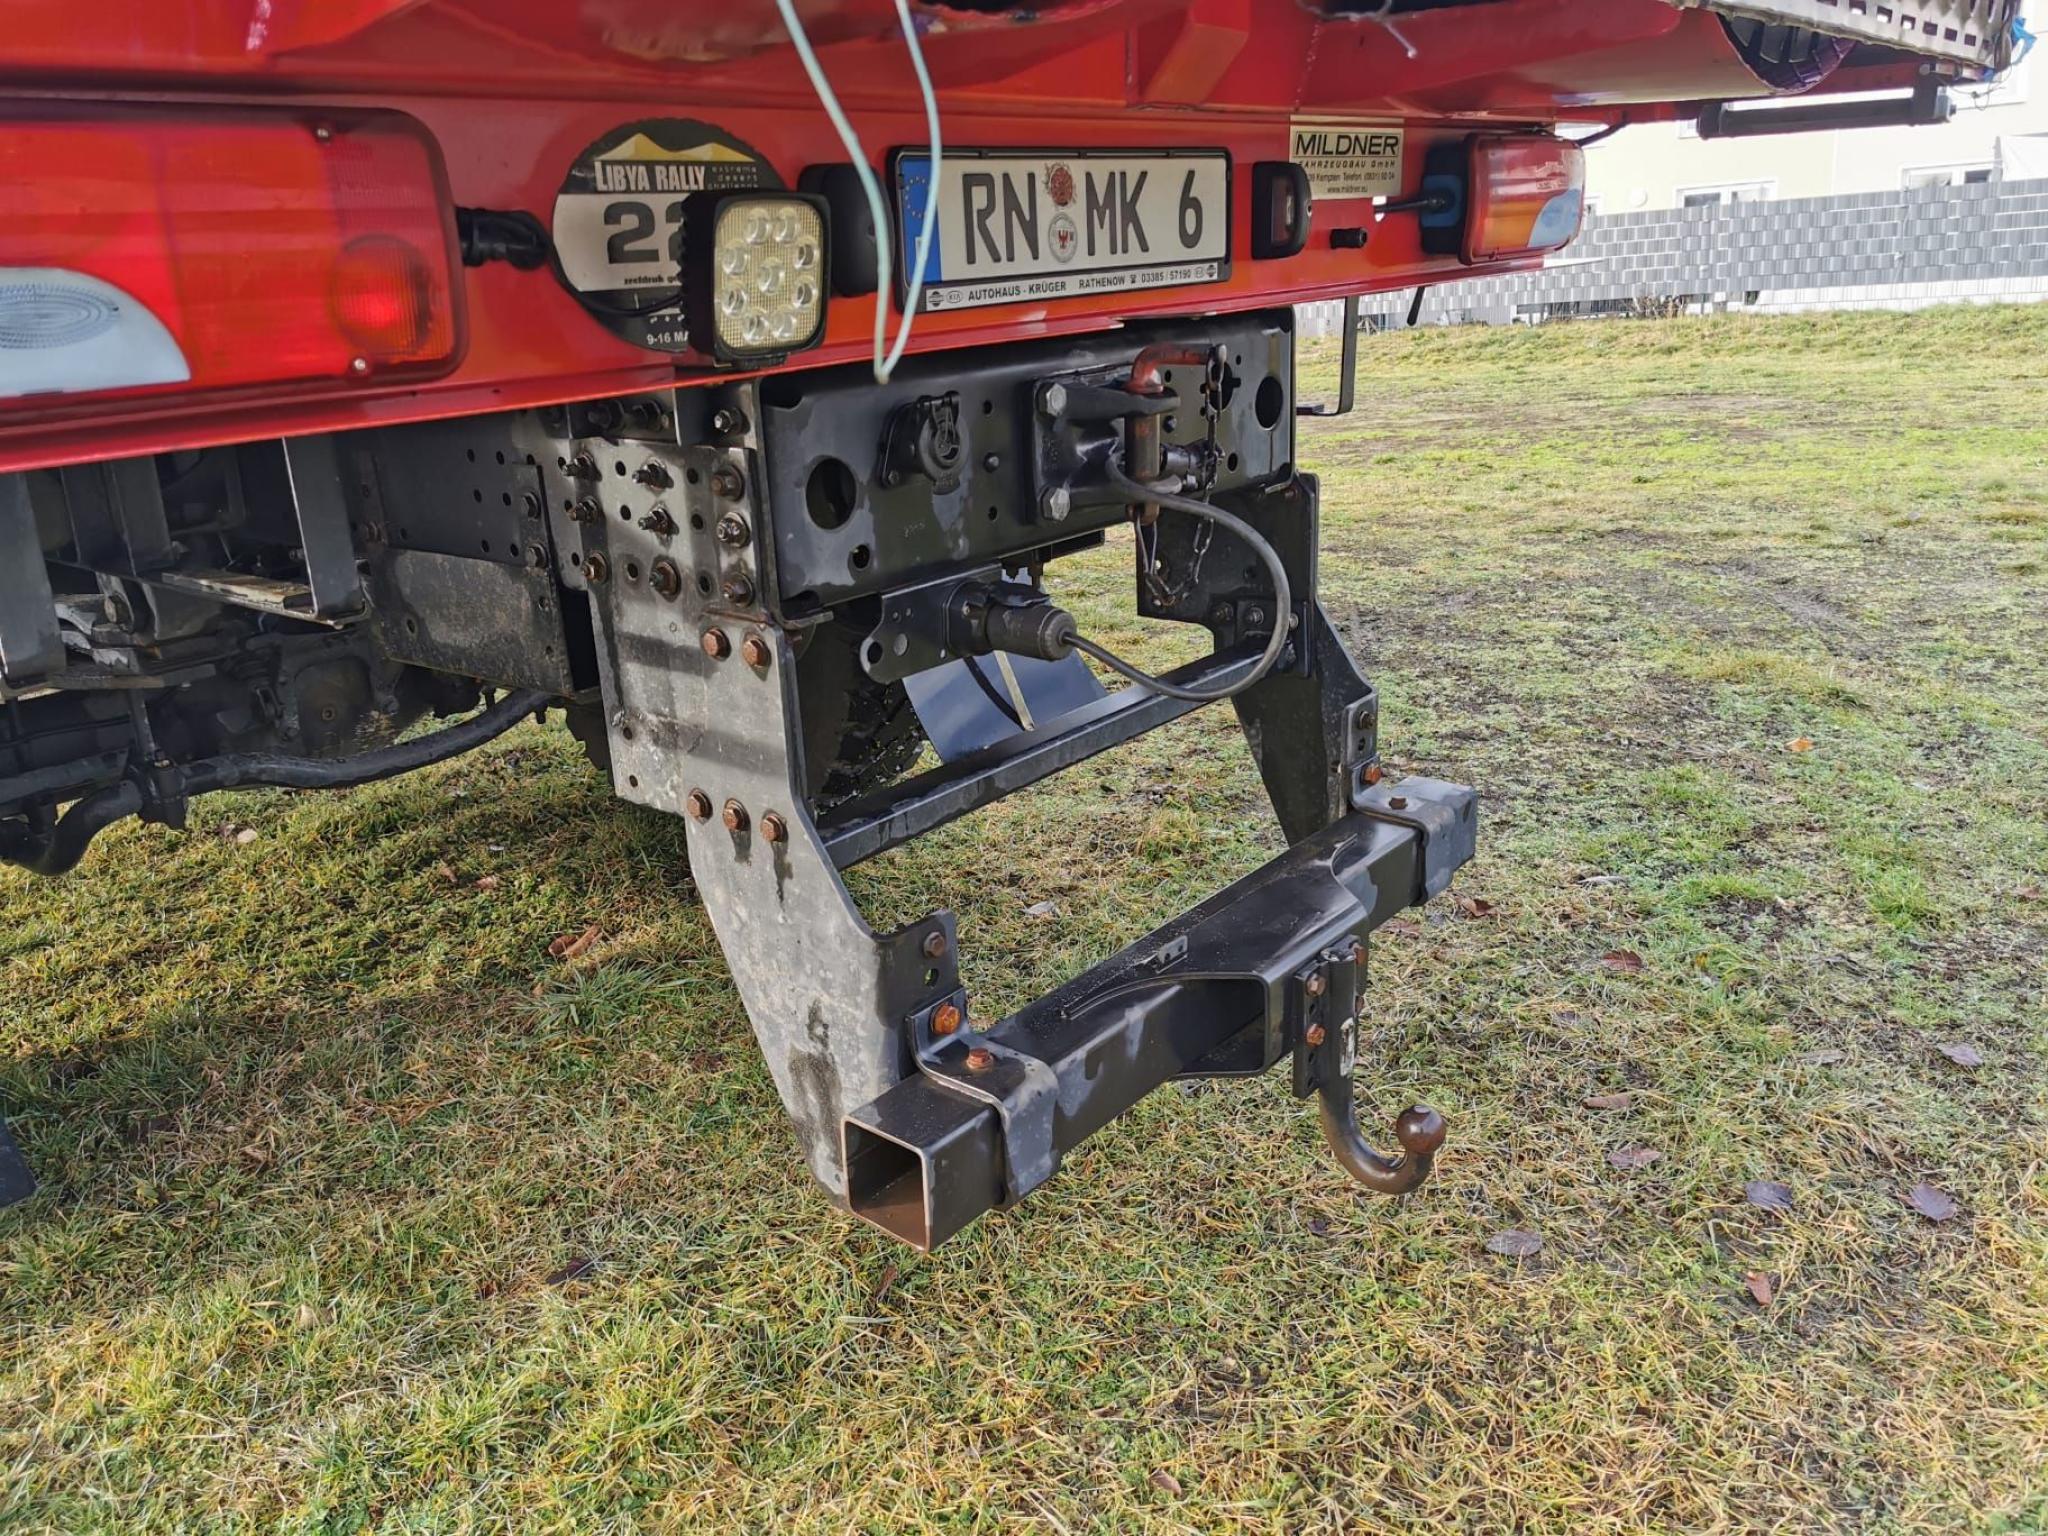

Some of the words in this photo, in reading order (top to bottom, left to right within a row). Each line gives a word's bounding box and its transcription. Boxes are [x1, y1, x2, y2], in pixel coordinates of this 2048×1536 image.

[1295, 133, 1399, 156] MILDNER
[594, 160, 650, 192] LIBYA
[654, 164, 706, 192] RALLY
[718, 174, 758, 182] desert
[962, 171, 1040, 265] RN
[1085, 170, 1150, 257] MK
[1178, 169, 1203, 249] 6
[968, 286, 1021, 302] AUTOHAUS
[1028, 281, 1066, 295] KRÜGER
[1079, 276, 1125, 289] RATHENOW
[646, 332, 671, 345] 9-16
